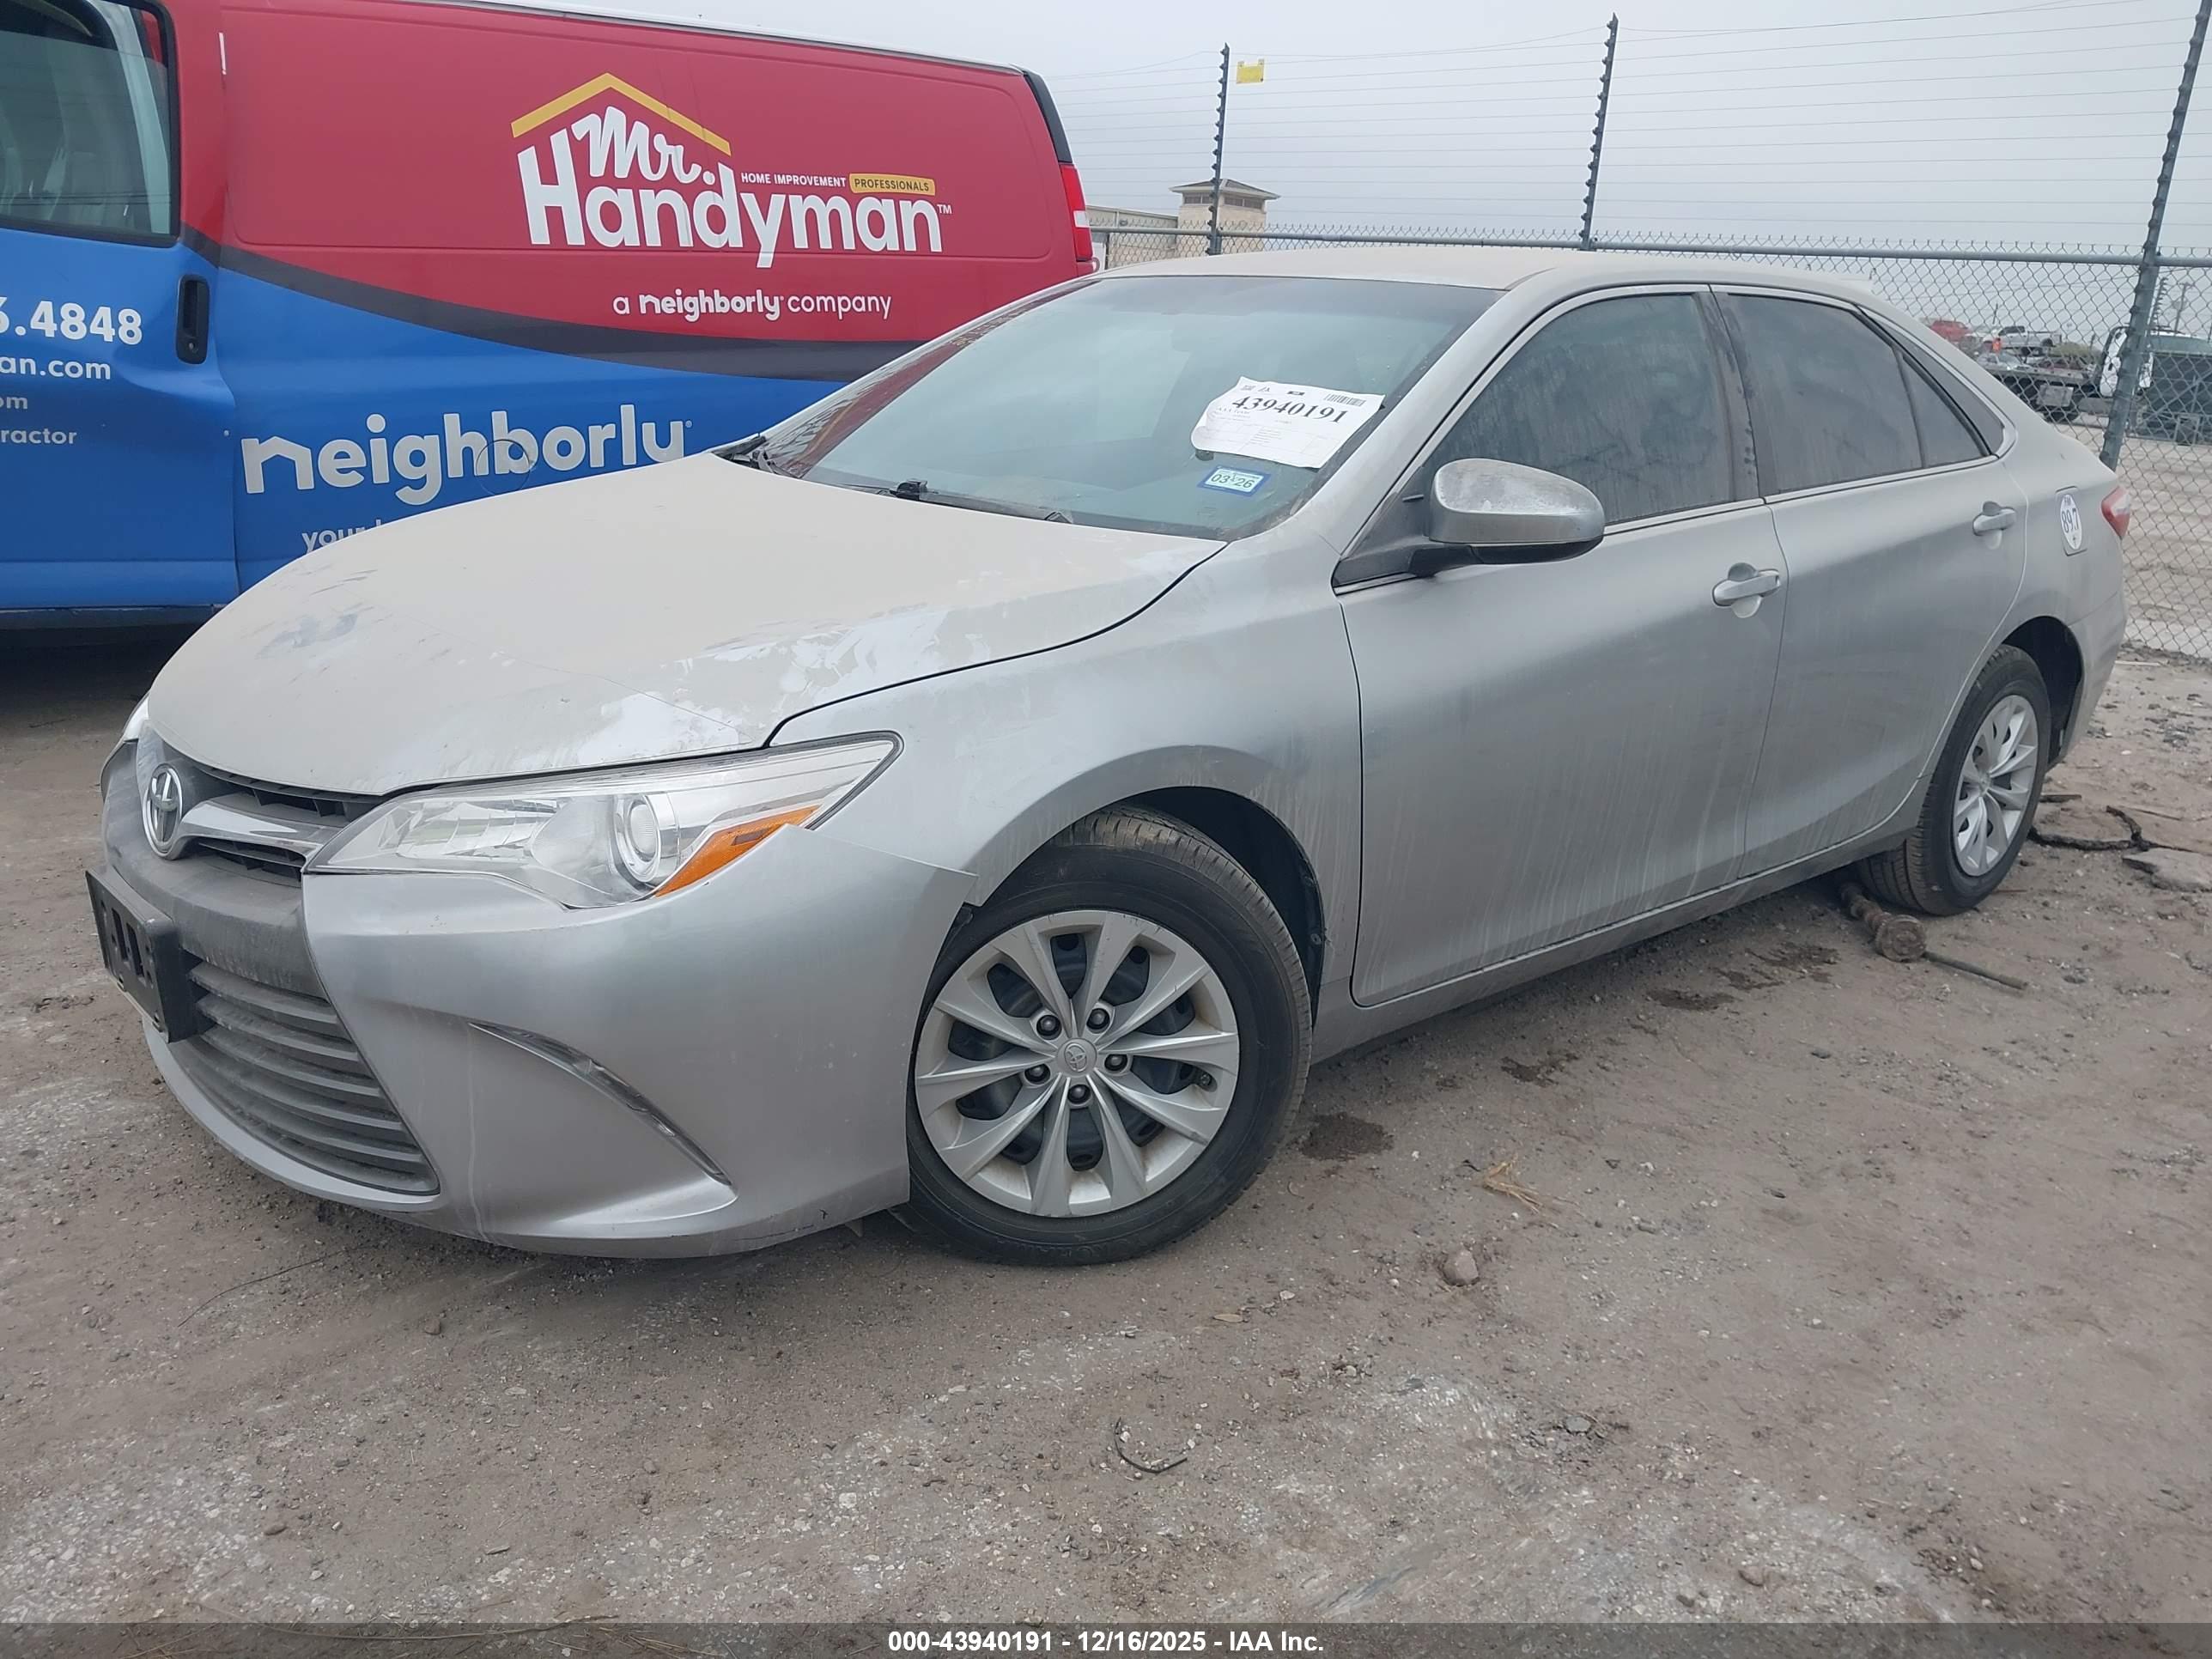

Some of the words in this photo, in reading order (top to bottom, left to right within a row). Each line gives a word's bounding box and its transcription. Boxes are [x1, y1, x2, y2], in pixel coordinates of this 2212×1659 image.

[570, 105, 716, 185] Mr.
[741, 172, 771, 185] HOME
[774, 173, 847, 188] IMPROVEMENT
[854, 178, 930, 192] PROFESSIONALS
[517, 127, 943, 268] Handyman
[612, 296, 630, 315] a
[639, 289, 781, 323] neighborly
[787, 295, 892, 320] company
[1231, 396, 1349, 423] 43940191
[1235, 477, 1255, 489] 26
